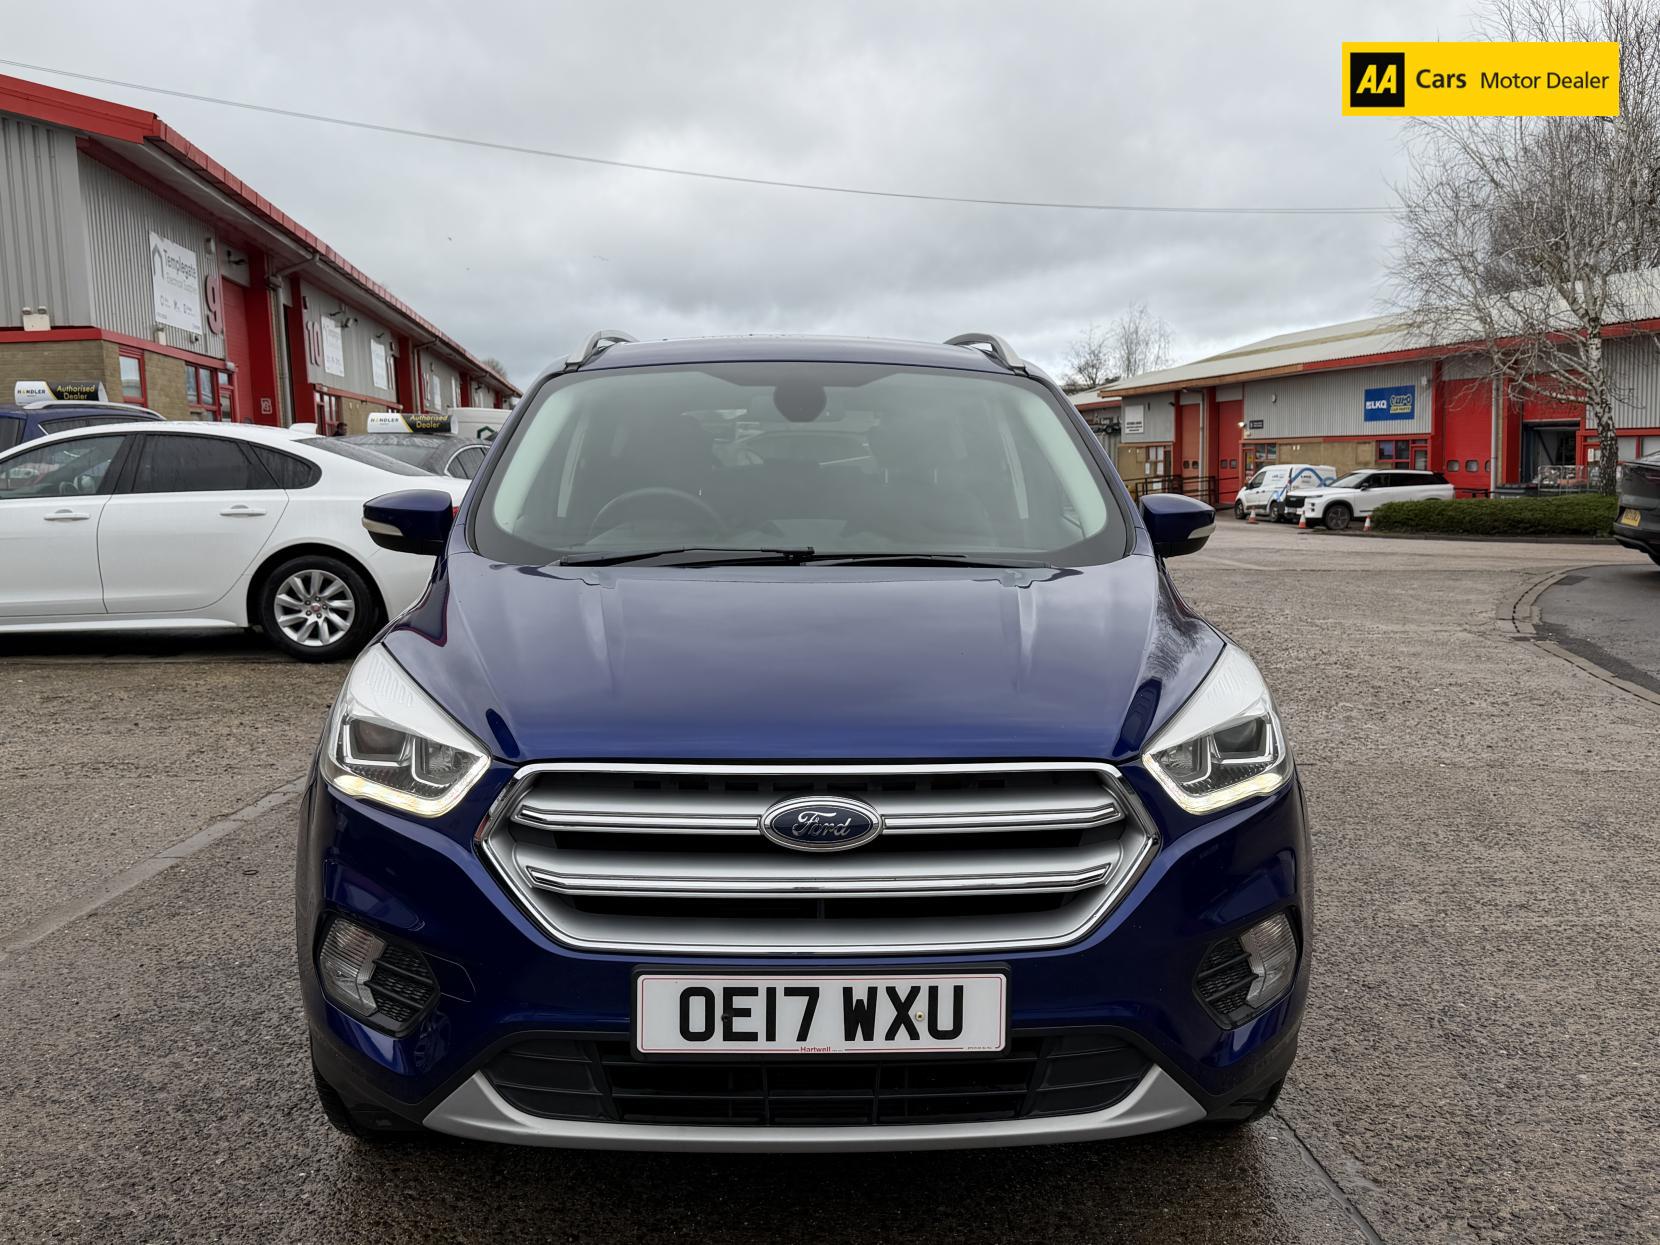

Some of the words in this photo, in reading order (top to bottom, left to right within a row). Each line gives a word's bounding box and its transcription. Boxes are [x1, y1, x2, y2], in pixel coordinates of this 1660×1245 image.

[163, 249, 197, 279] Templegate
[205, 275, 224, 335] 9
[306, 320, 321, 366] 10
[56, 384, 96, 392] Authorised
[416, 421, 441, 429] Dealer
[791, 810, 852, 836] Ford
[679, 986, 820, 1043] OE17
[842, 985, 964, 1041] WXU
[800, 1045, 831, 1054] Hartwell
